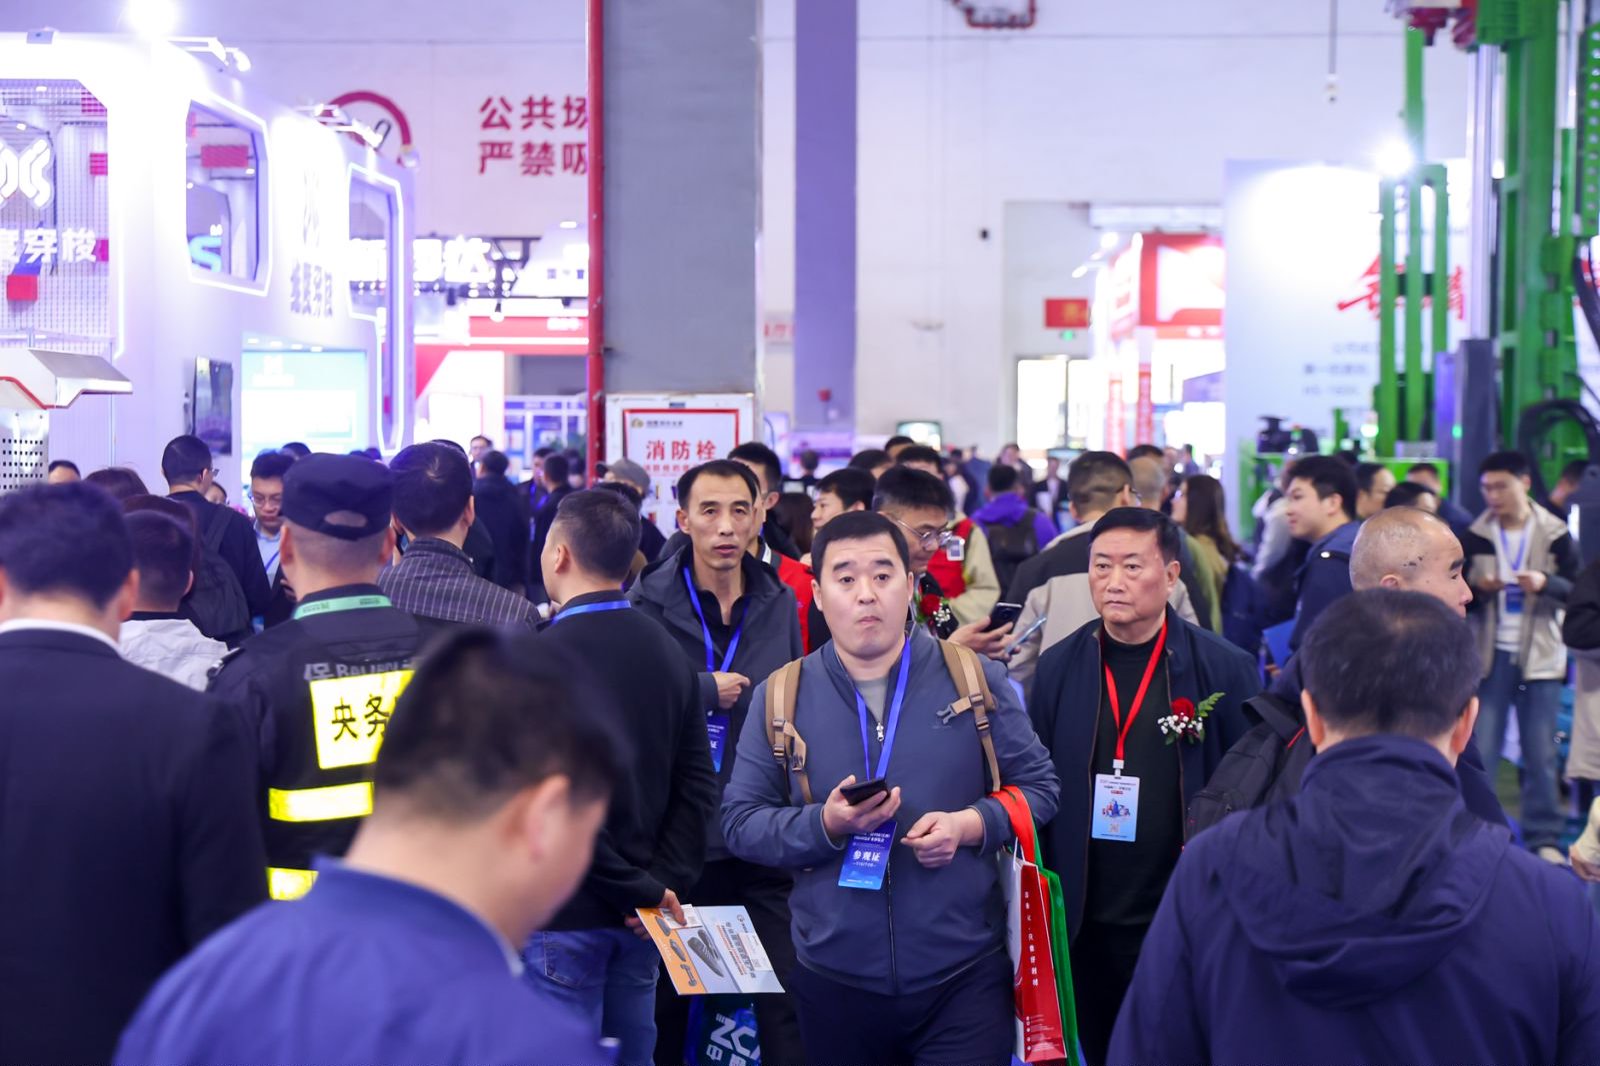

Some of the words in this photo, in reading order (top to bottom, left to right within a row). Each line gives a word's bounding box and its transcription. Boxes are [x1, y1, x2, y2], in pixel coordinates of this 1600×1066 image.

[479, 95, 587, 130] 公共场
[479, 141, 587, 176] 严禁吸
[646, 440, 717, 461] 消防栓
